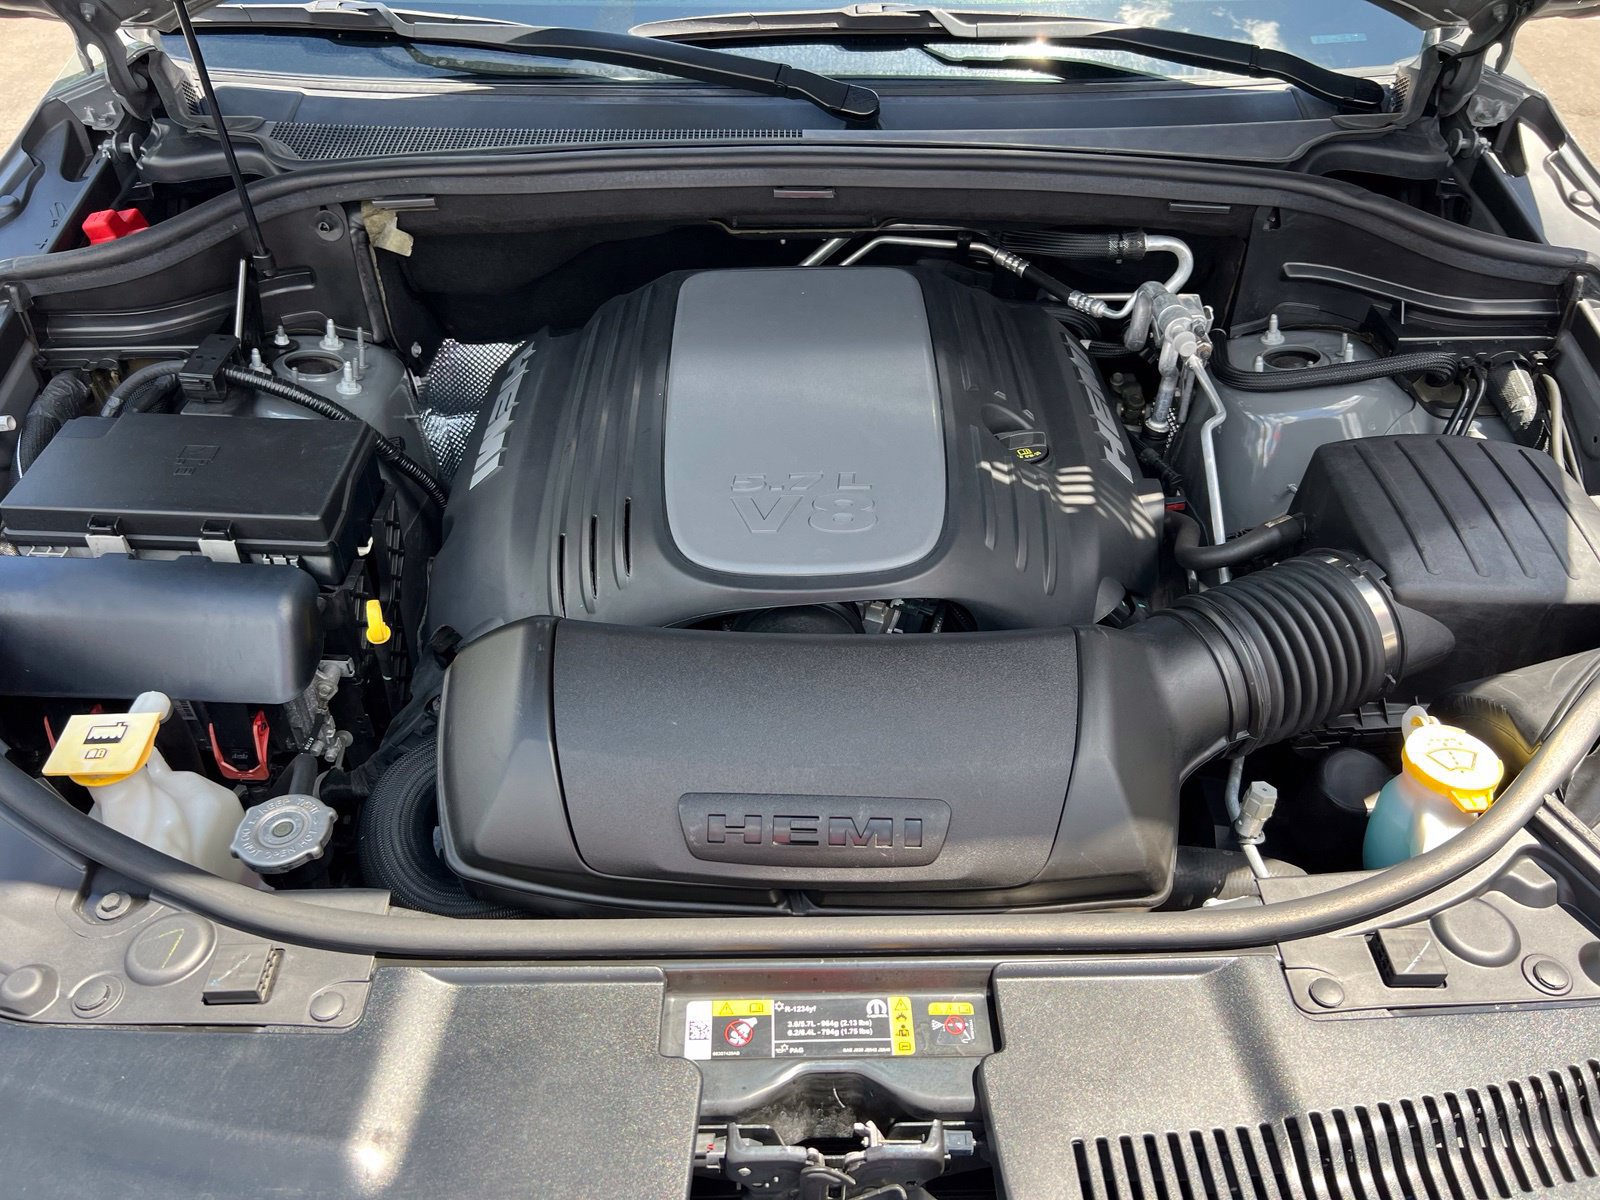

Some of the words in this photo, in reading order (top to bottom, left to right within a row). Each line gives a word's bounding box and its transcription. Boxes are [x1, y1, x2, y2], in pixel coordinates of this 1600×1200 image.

[469, 341, 536, 491] HEMI
[1063, 333, 1134, 484] HEMI
[730, 494, 879, 534] V8
[259, 798, 291, 815] KEEP
[707, 814, 923, 849] HEMI
[784, 1005, 817, 1014] R-1234yf
[787, 1020, 816, 1028] 3.6/5.7L
[840, 1019, 858, 1028] (2.13
[858, 1019, 873, 1027] lbs)
[840, 1028, 858, 1036] (1.75
[858, 1027, 873, 1036] lbs)
